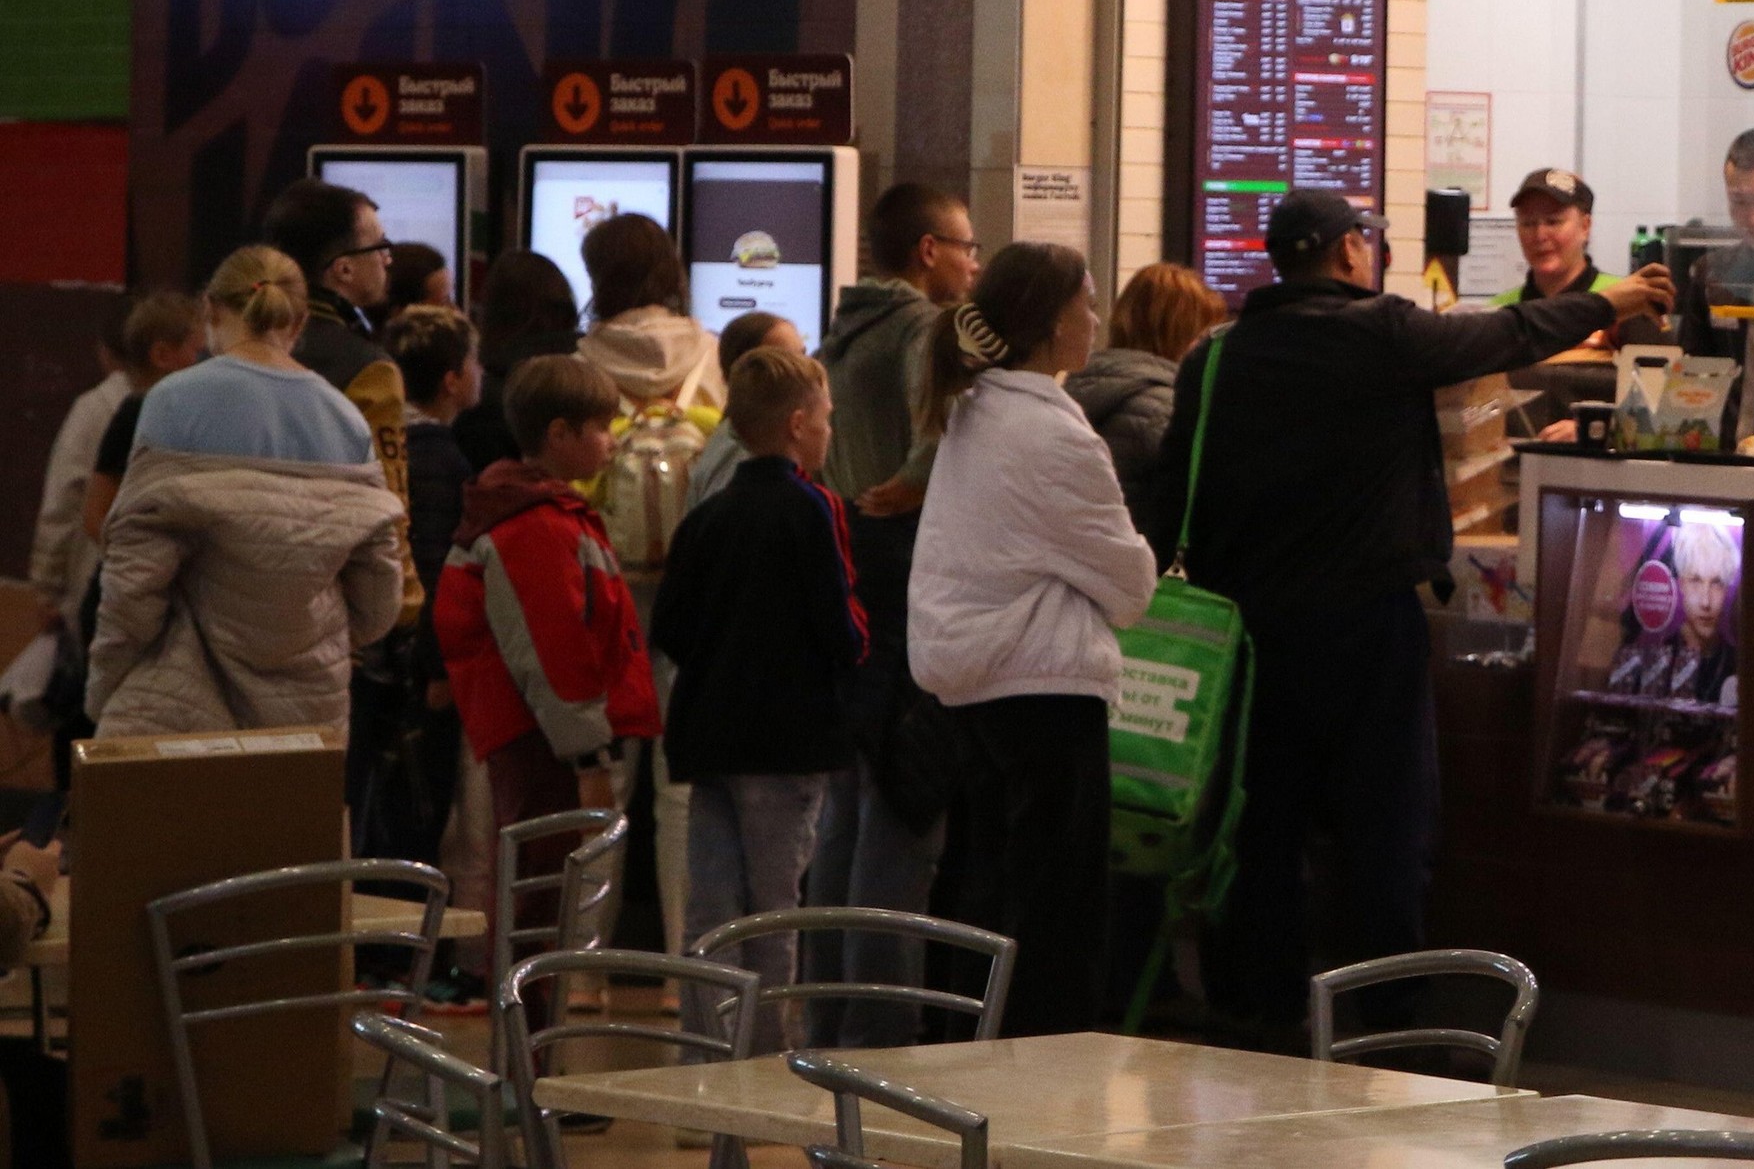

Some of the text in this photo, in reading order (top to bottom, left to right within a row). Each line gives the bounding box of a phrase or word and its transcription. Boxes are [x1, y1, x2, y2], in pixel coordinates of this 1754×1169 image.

[399, 75, 475, 97] Быстрый
[609, 72, 687, 96] Быстрый
[767, 68, 843, 91] Быстрый
[399, 98, 446, 115] заказ
[609, 96, 657, 113] заказ
[767, 92, 813, 109] заказ
